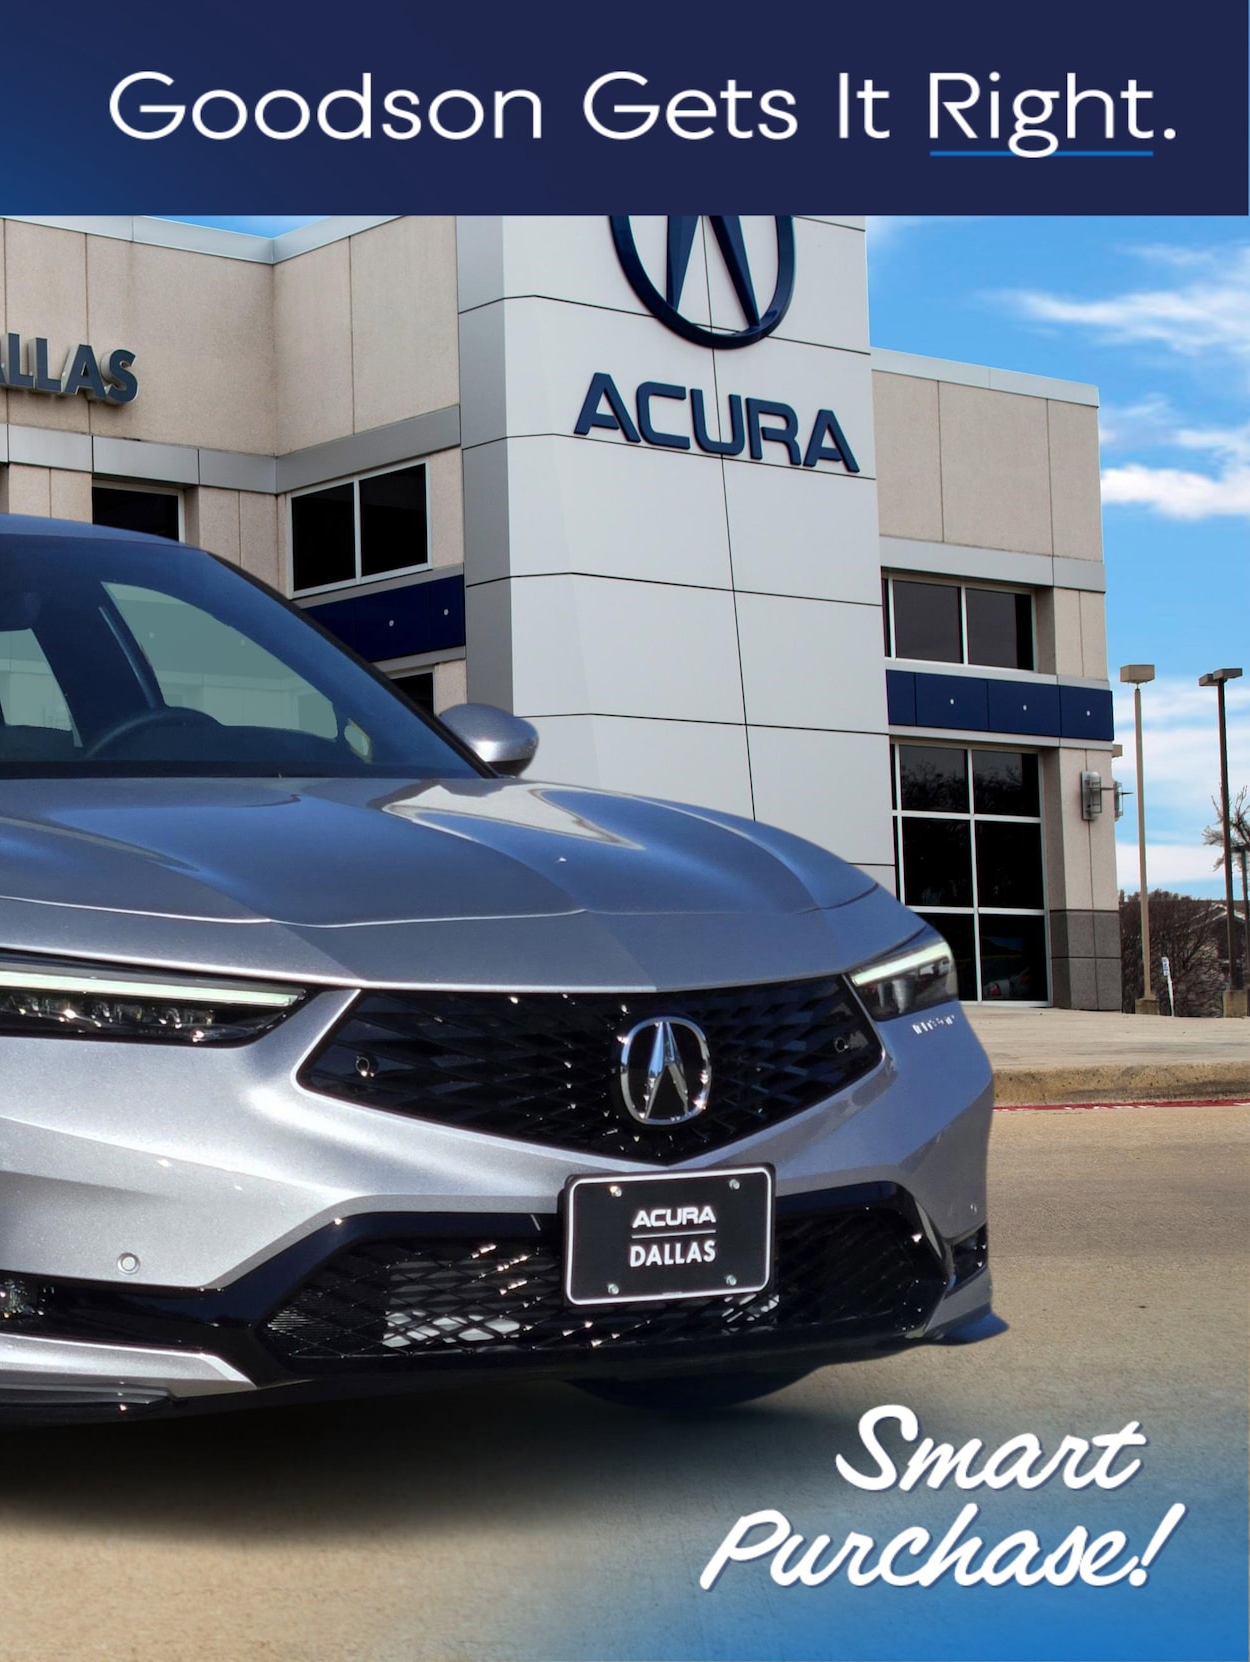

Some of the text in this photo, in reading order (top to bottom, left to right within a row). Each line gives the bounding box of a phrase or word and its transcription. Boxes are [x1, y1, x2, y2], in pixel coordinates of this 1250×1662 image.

[573, 372, 860, 473] ACURA
[632, 1205, 717, 1229] ACURA
[629, 1239, 716, 1268] DALLAS
